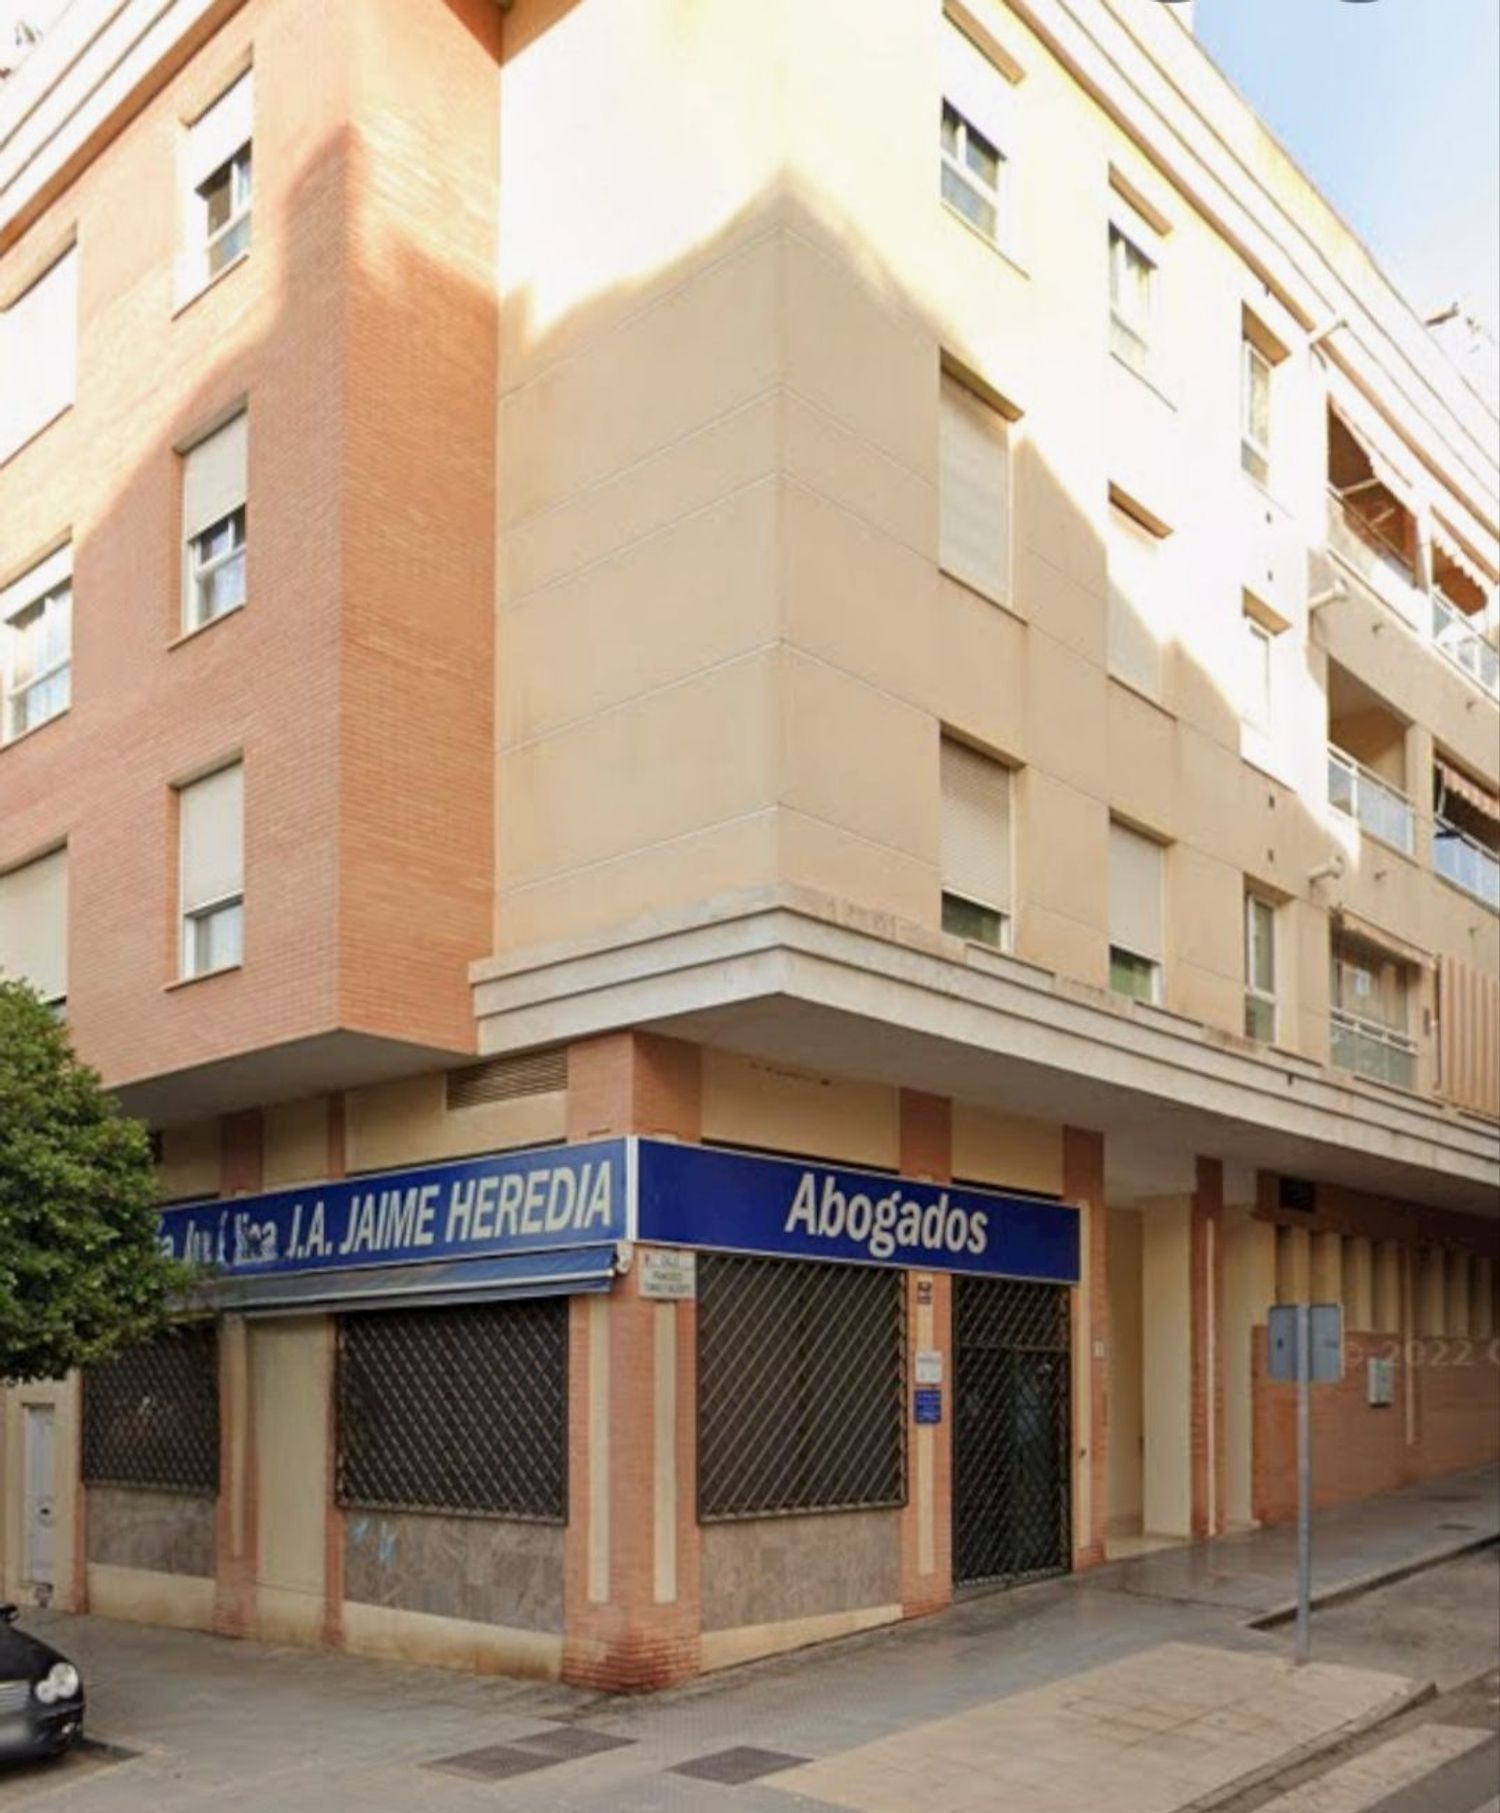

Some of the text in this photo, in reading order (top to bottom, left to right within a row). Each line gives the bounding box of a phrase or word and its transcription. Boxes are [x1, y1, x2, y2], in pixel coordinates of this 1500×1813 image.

[286, 1203, 333, 1259] J.A.
[339, 1184, 440, 1255] JAIME
[445, 1160, 612, 1243] HEREDIA
[785, 1172, 989, 1259] Abogados
